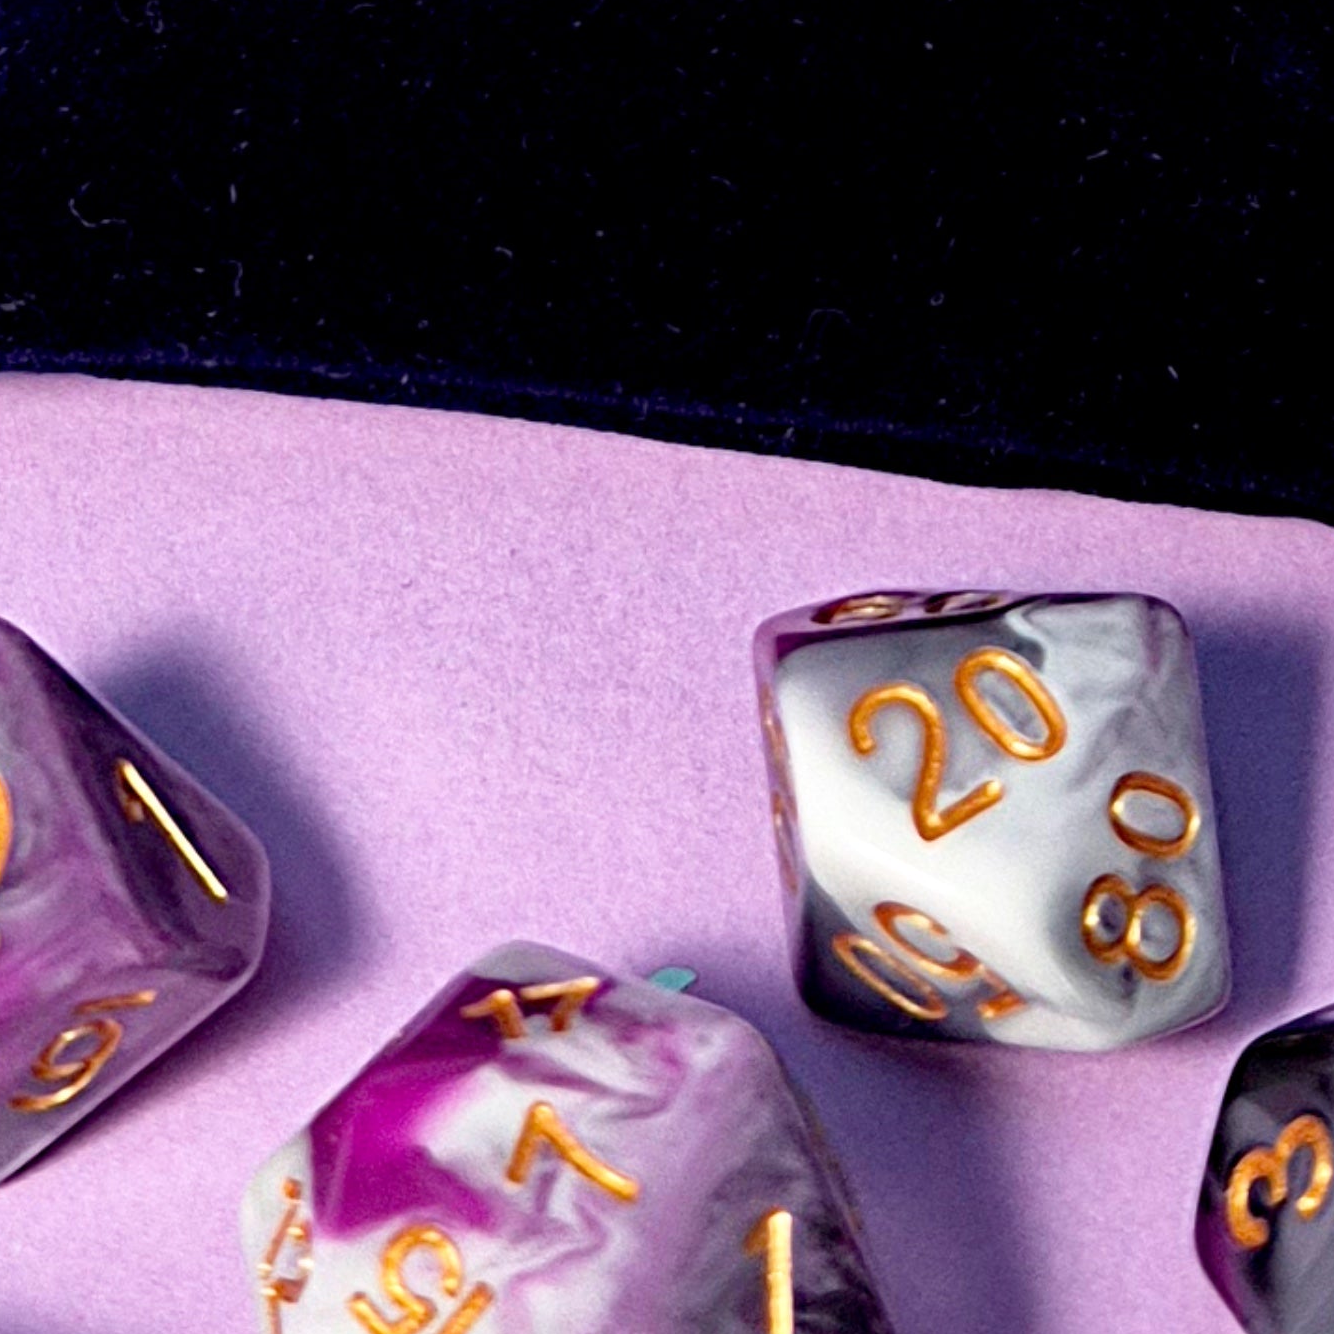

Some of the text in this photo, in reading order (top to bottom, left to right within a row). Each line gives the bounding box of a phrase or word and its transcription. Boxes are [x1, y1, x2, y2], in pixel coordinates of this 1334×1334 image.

[845, 644, 1069, 843] 20
[120, 758, 228, 901] 1
[1081, 770, 1202, 983] 80
[460, 975, 602, 1040] 17
[831, 899, 1028, 1020] 50
[504, 1100, 640, 1205] 7
[1225, 1111, 1334, 1250] 3
